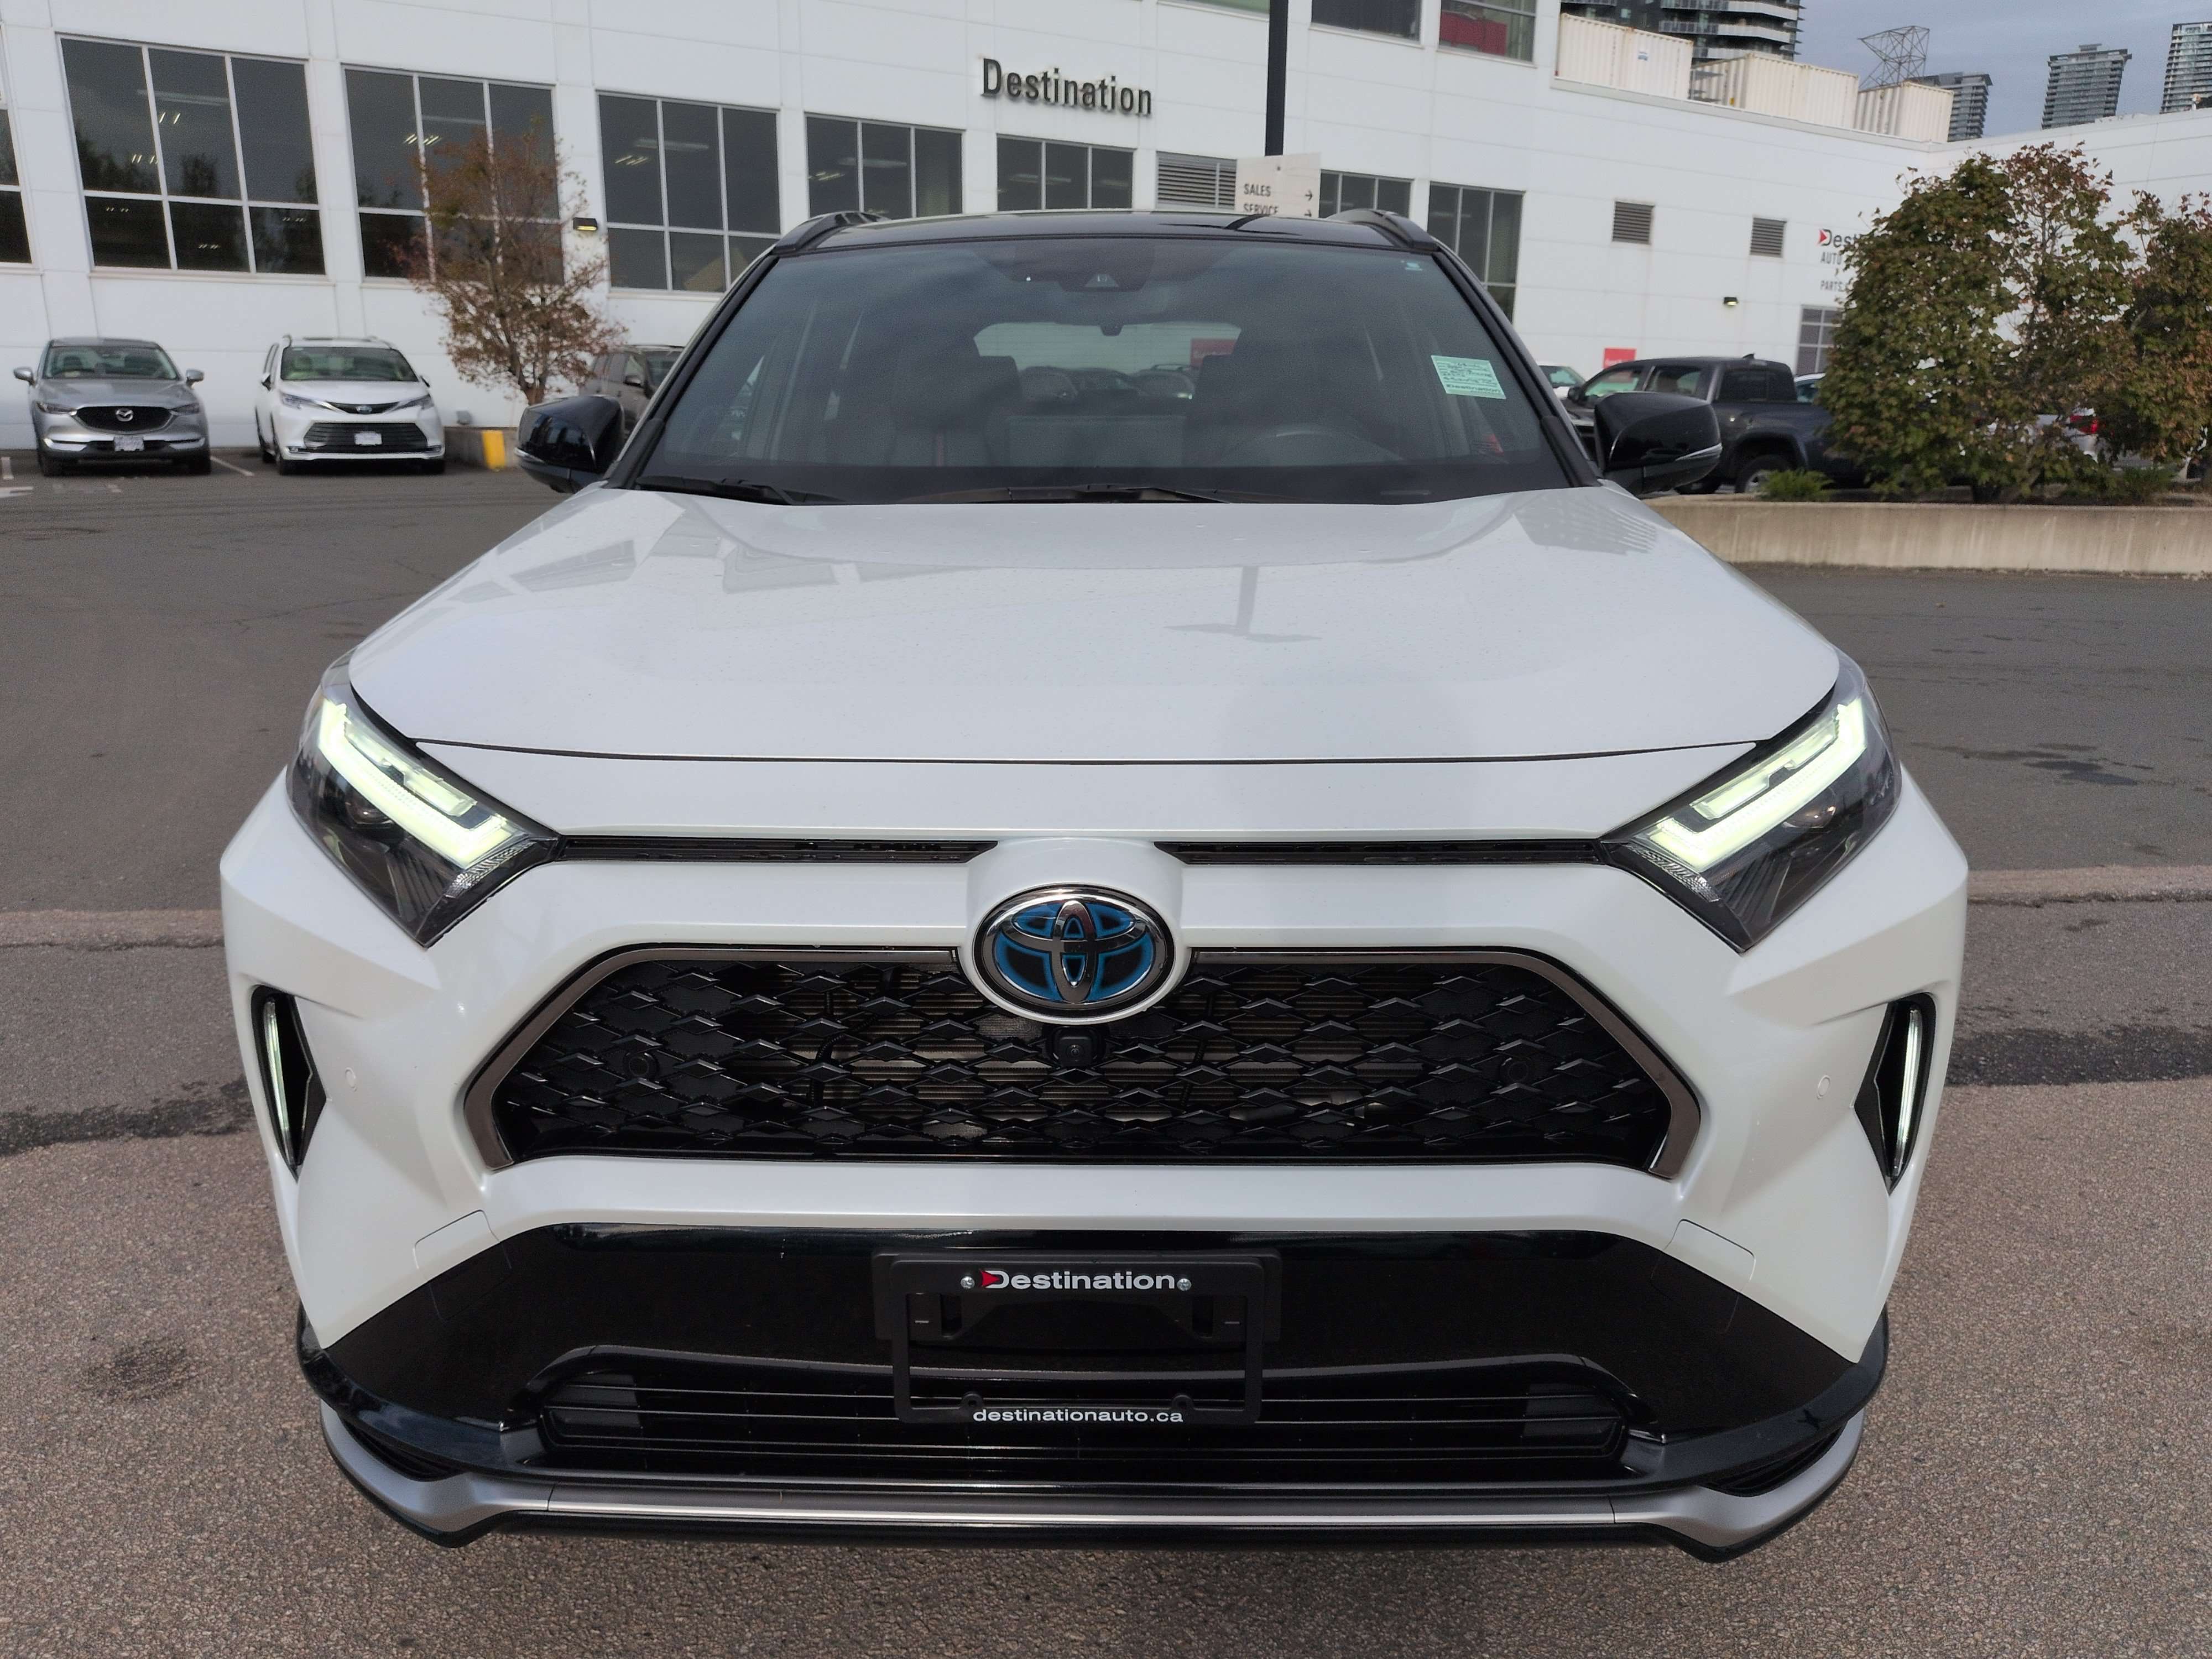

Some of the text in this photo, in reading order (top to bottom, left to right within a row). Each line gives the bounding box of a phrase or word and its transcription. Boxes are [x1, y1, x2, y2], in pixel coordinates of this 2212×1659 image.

[982, 58, 1152, 114] Destination
[1244, 184, 1271, 197] SALES
[1243, 204, 1279, 215] SERVICE
[1820, 252, 1842, 265] AUTO
[982, 1270, 1175, 1290] Destination
[973, 1408, 1183, 1423] destinationauto.ca
